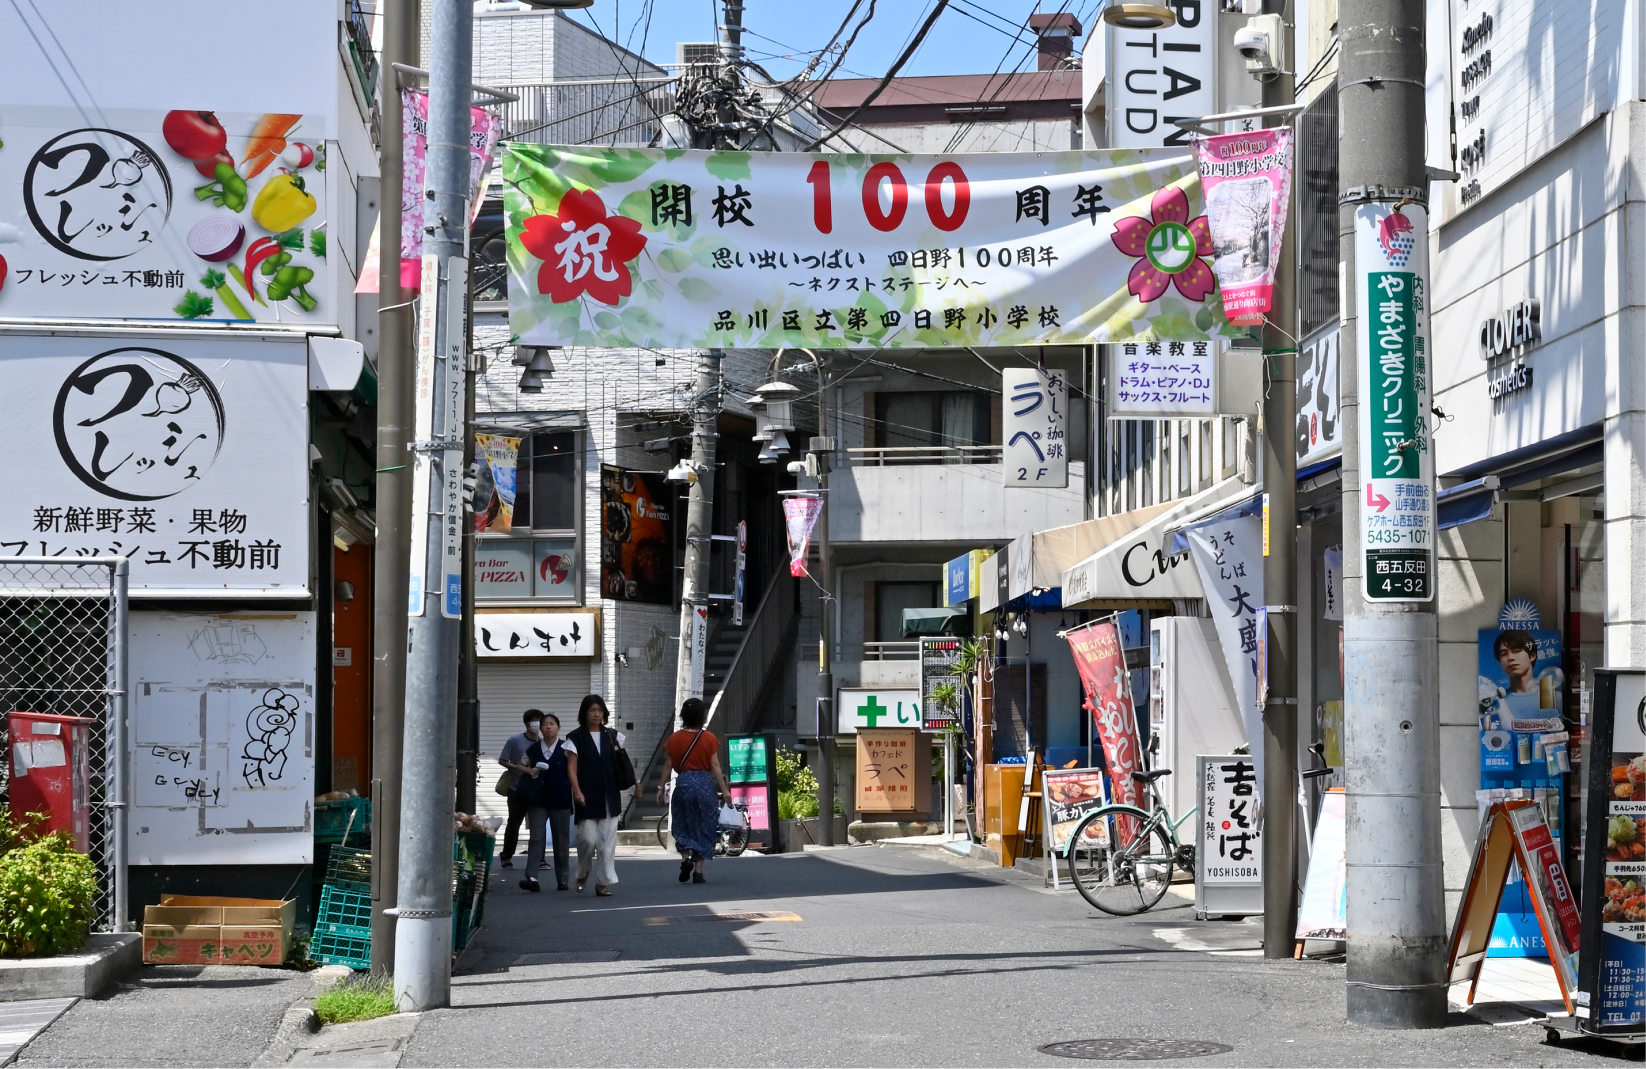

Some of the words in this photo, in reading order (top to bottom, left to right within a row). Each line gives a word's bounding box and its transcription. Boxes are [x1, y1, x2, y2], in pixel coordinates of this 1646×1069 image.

[1199, 152, 1286, 178] 第四日野小学校
[650, 183, 755, 228] 開校
[806, 160, 971, 234] 100
[1015, 184, 1111, 227] 周年
[554, 220, 620, 284] 祝
[711, 247, 865, 270] 思い出いっぱい
[887, 245, 1059, 270] 四日野100周年
[15, 268, 185, 289] フレッシュ不動前
[713, 305, 1061, 332] 品川区立第四日野小学校
[1478, 297, 1541, 361] CLOVER
[1123, 342, 1208, 357] 音楽教室
[1128, 362, 1201, 374] ギター・ベース
[1411, 275, 1428, 455] 内科・胃腸科・外科
[1377, 273, 1406, 476] やまざきクリニック
[1488, 364, 1533, 400] cosmetics
[1120, 377, 1210, 389] ドラム・ピアノ・DJ
[1118, 392, 1211, 404] サックス・フルート
[1008, 381, 1046, 464] ラペ
[1047, 373, 1064, 460] おいしい珈琲
[1394, 483, 1430, 497] 手前曲る
[1395, 498, 1430, 511] 山手通り渡る
[32, 505, 248, 534] 新鮮野菜・果物
[1367, 515, 1430, 528] ケアホーム西五反田1F
[1367, 530, 1430, 544] 5435-1071
[489, 559, 508, 568] Bar
[1376, 560, 1426, 574] 西五反田
[480, 571, 525, 583] PIZZA
[1381, 578, 1423, 592] 4-32
[1499, 621, 1540, 631] ANESSA
[864, 763, 908, 779] ラペ
[1219, 760, 1260, 862] 吉そば
[1207, 867, 1258, 877] YOSHISOBA
[243, 931, 274, 939] 真空予冷
[200, 942, 274, 959] キャベツ
[1607, 1012, 1626, 1021] TEL
[1630, 1012, 1641, 1021] 03
